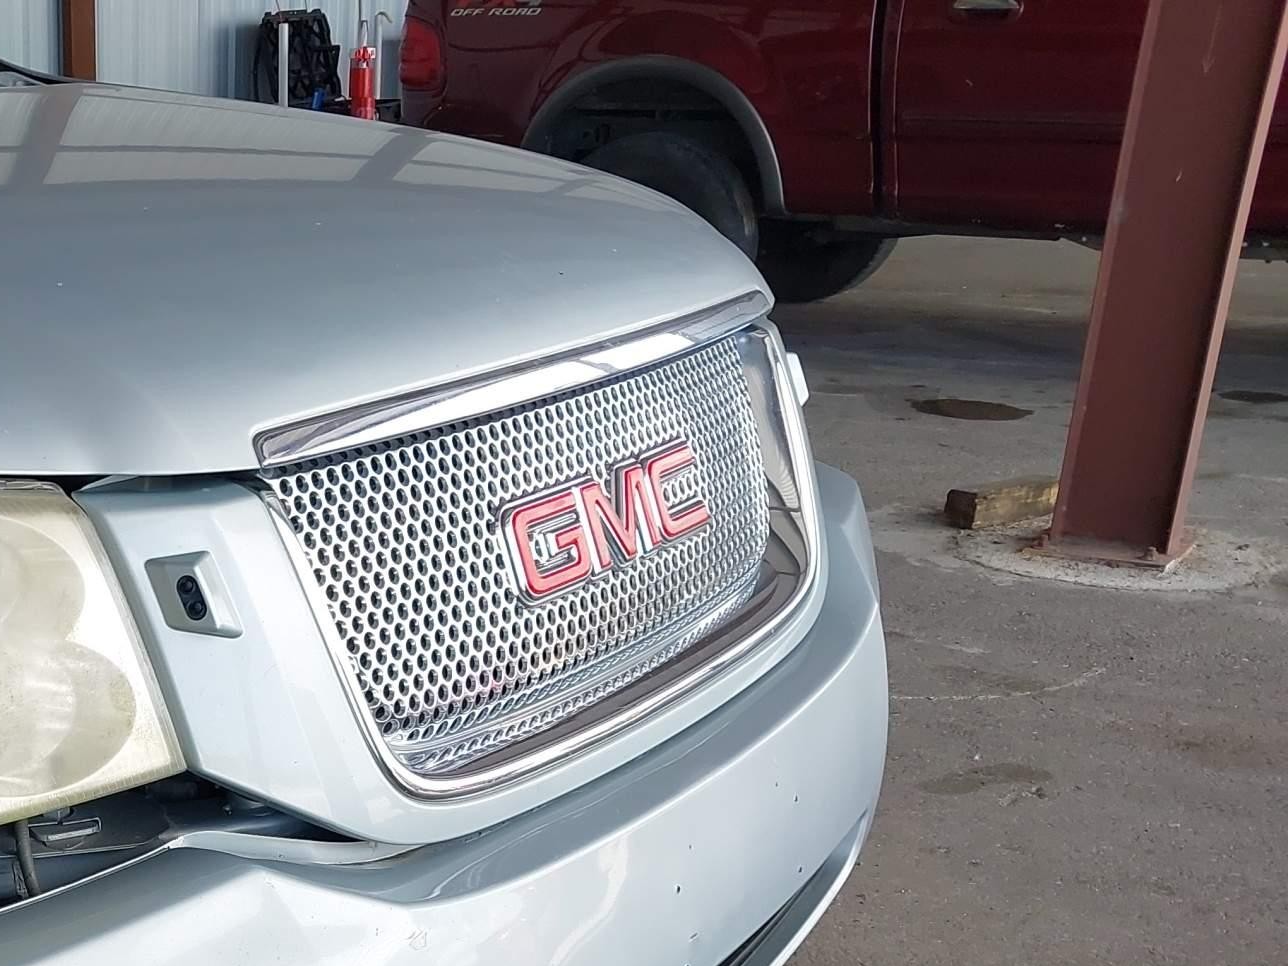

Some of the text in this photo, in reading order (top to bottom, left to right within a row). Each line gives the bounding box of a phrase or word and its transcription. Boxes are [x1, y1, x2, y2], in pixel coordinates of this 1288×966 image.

[450, 7, 542, 17] OFF ROAD
[502, 439, 712, 603] GMC
